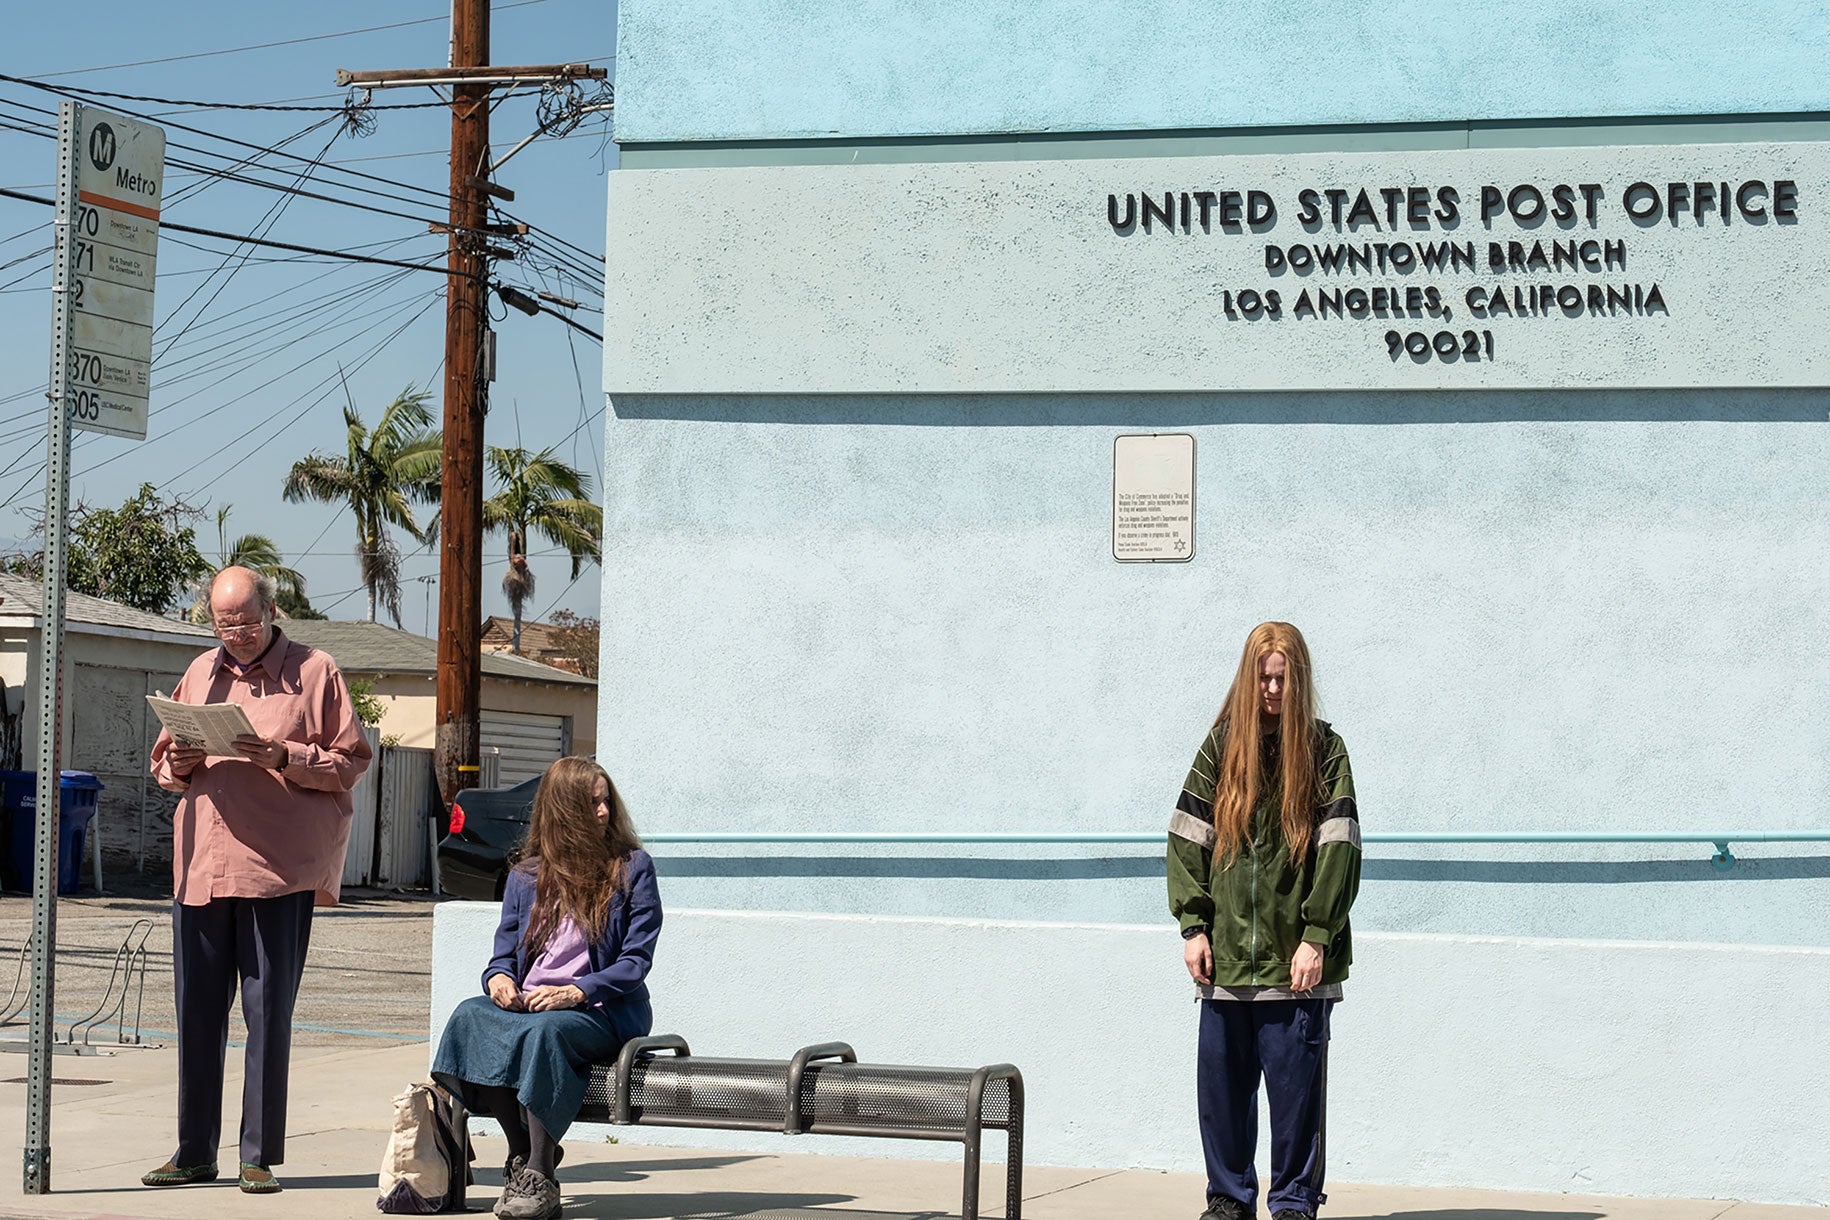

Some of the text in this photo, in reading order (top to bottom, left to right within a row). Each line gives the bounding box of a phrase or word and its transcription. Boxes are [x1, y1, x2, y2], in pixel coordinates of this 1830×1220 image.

[116, 166, 156, 196] Metro
[1107, 180, 1797, 229] UNITED STATES POST OFFICE
[77, 205, 100, 237] 70
[110, 220, 132, 231] Downtown
[76, 241, 95, 272] 71
[120, 258, 133, 268] Transit
[1265, 239, 1625, 270] DOWNTOWN BRANCH
[116, 265, 136, 276] Downtown
[1223, 283, 1668, 321] LOS ANGELES, CALIFORNIA
[1384, 330, 1493, 356] 90021
[103, 365, 123, 374] Downtown
